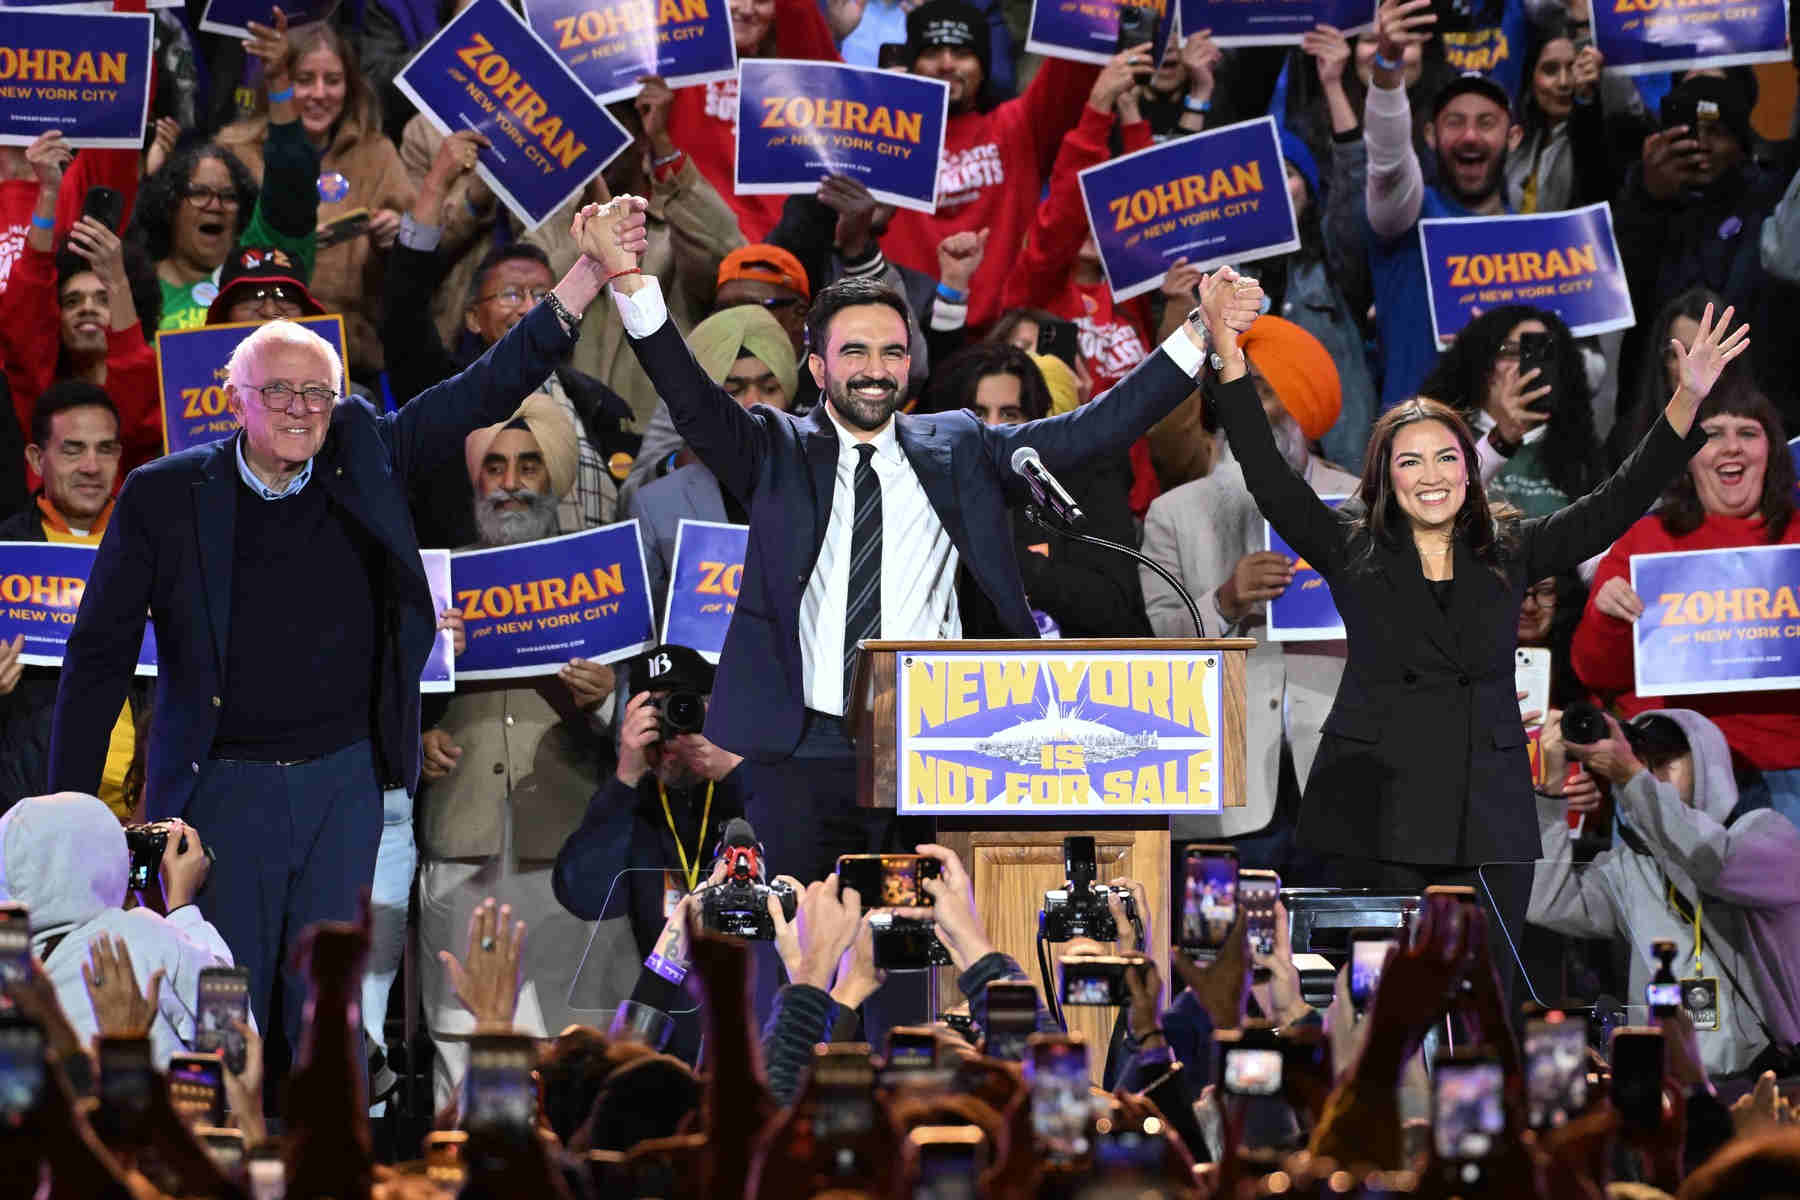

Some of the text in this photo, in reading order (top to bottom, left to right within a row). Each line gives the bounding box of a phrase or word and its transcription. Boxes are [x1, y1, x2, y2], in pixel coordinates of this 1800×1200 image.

[553, 0, 710, 50] ZOHAN
[672, 25, 705, 41] CITY
[36, 88, 78, 102] YORK
[81, 89, 118, 103] CITY
[456, 32, 588, 169] ZOHRAN
[466, 82, 496, 113] NEW
[496, 111, 528, 149] YORK
[525, 145, 555, 175] CITY
[760, 96, 923, 145] ZOHRAN
[790, 135, 830, 148] NEW
[833, 135, 874, 151] YORK
[876, 142, 912, 159] CITY
[1108, 160, 1264, 233] ZOHRAN
[1143, 219, 1177, 240] NEW
[1179, 208, 1222, 228] YORK
[1223, 199, 1259, 218] CITY
[1446, 243, 1598, 288] ZOHRAN
[1479, 289, 1514, 302] NEW
[1516, 284, 1556, 298] YORK
[1559, 278, 1593, 294] CITY
[0, 574, 86, 608] OHR
[456, 562, 626, 621] ZOHRAN
[1659, 585, 1800, 628] ZOHRA
[9, 607, 47, 622] NEW
[496, 619, 534, 636] NEW
[537, 612, 581, 631] YORK
[584, 601, 620, 621] CITY
[1694, 629, 1731, 643] NEW
[1736, 625, 1780, 641] YORK
[908, 660, 1212, 738] NEW YORK
[908, 749, 1212, 805] NOT FOR SALE
[1041, 744, 1085, 770] IS
